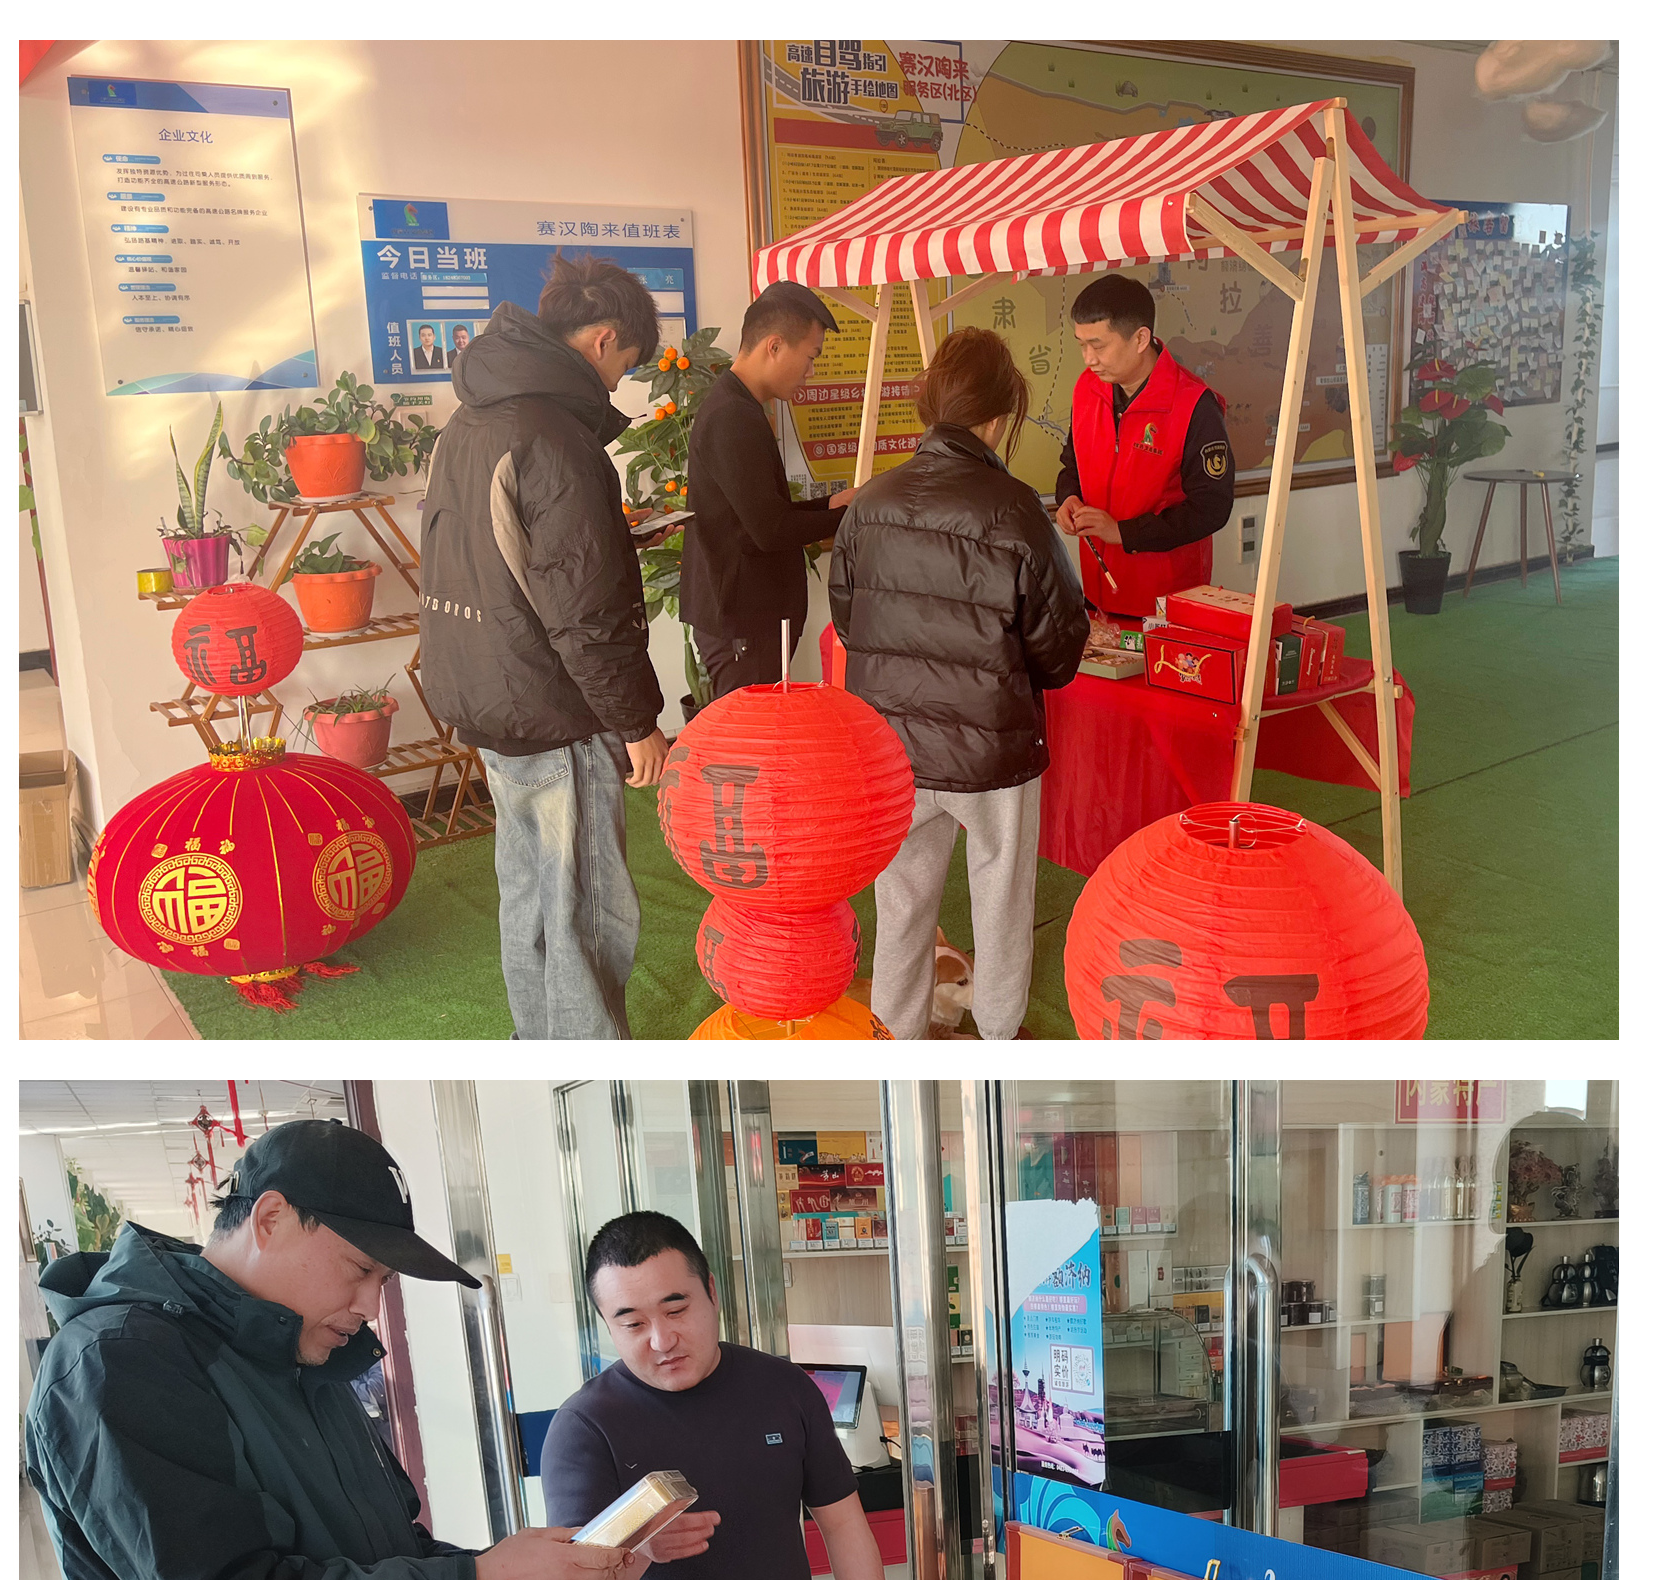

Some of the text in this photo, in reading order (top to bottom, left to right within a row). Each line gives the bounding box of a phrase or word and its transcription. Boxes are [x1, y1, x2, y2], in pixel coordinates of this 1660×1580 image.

[899, 50, 970, 80] 赛汉陶来
[800, 67, 899, 106] 旅游手绘地图
[158, 128, 214, 144] 企业文化
[537, 220, 681, 240] 赛汉陶来值班表
[377, 244, 488, 270] 今日当班
[381, 272, 418, 280] 监督电话
[386, 321, 404, 377] 值班人员
[152, 866, 229, 934] 福
[1053, 1349, 1069, 1363] 明码
[1053, 1364, 1069, 1379] 实价
